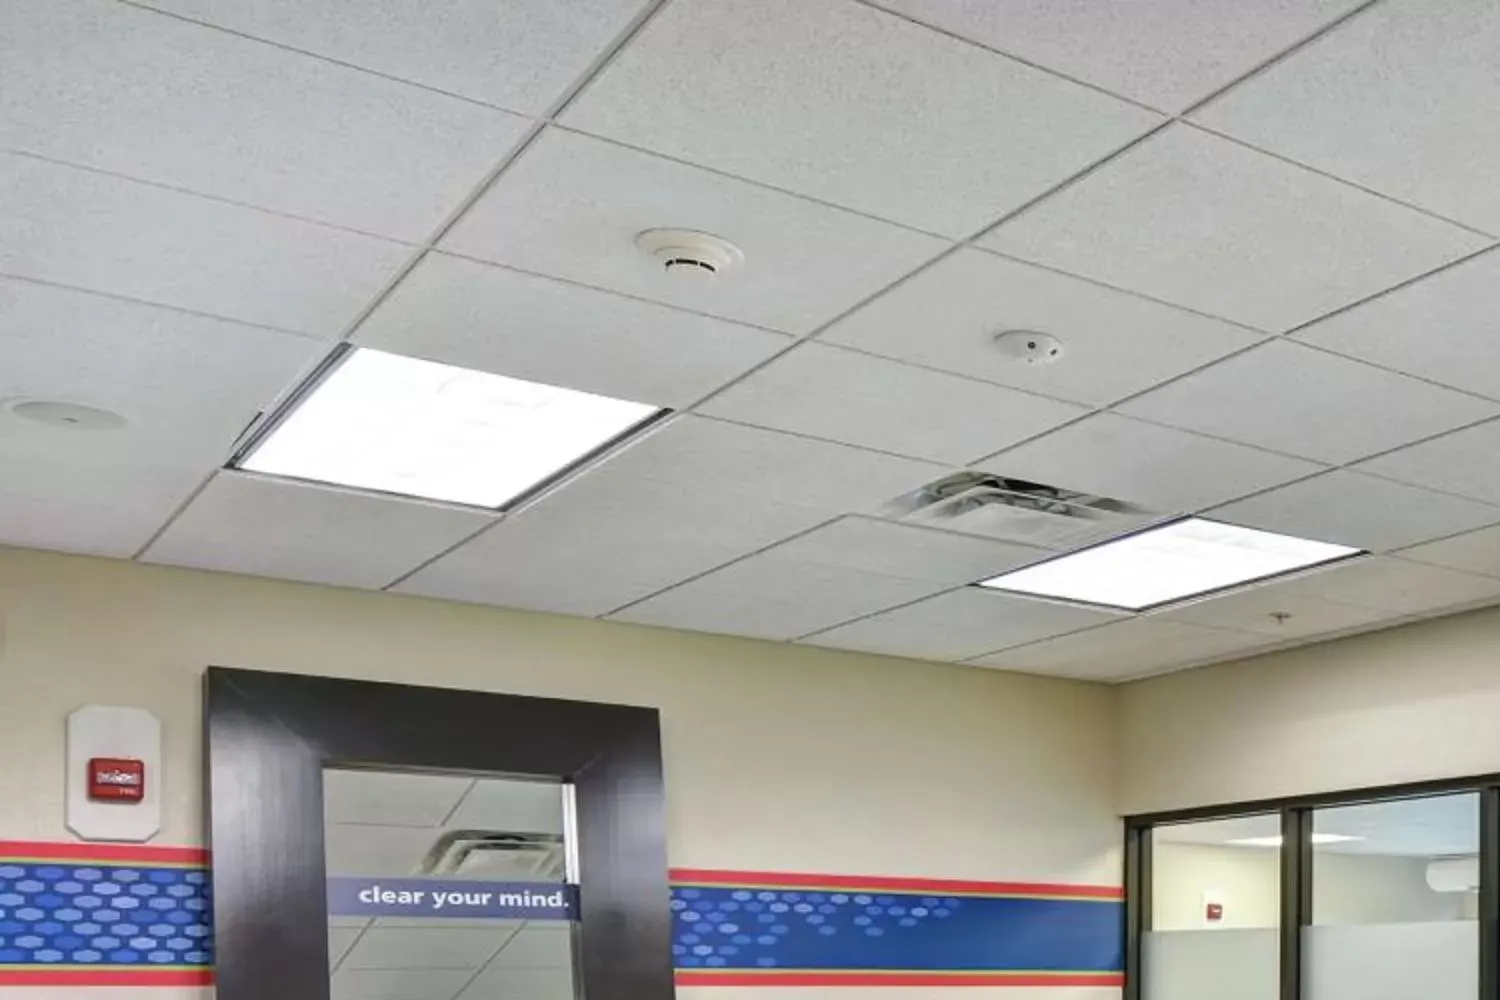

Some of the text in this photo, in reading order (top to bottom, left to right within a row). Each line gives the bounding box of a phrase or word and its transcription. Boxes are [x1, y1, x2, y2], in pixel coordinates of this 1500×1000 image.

[358, 886, 570, 908] clear your mind.
